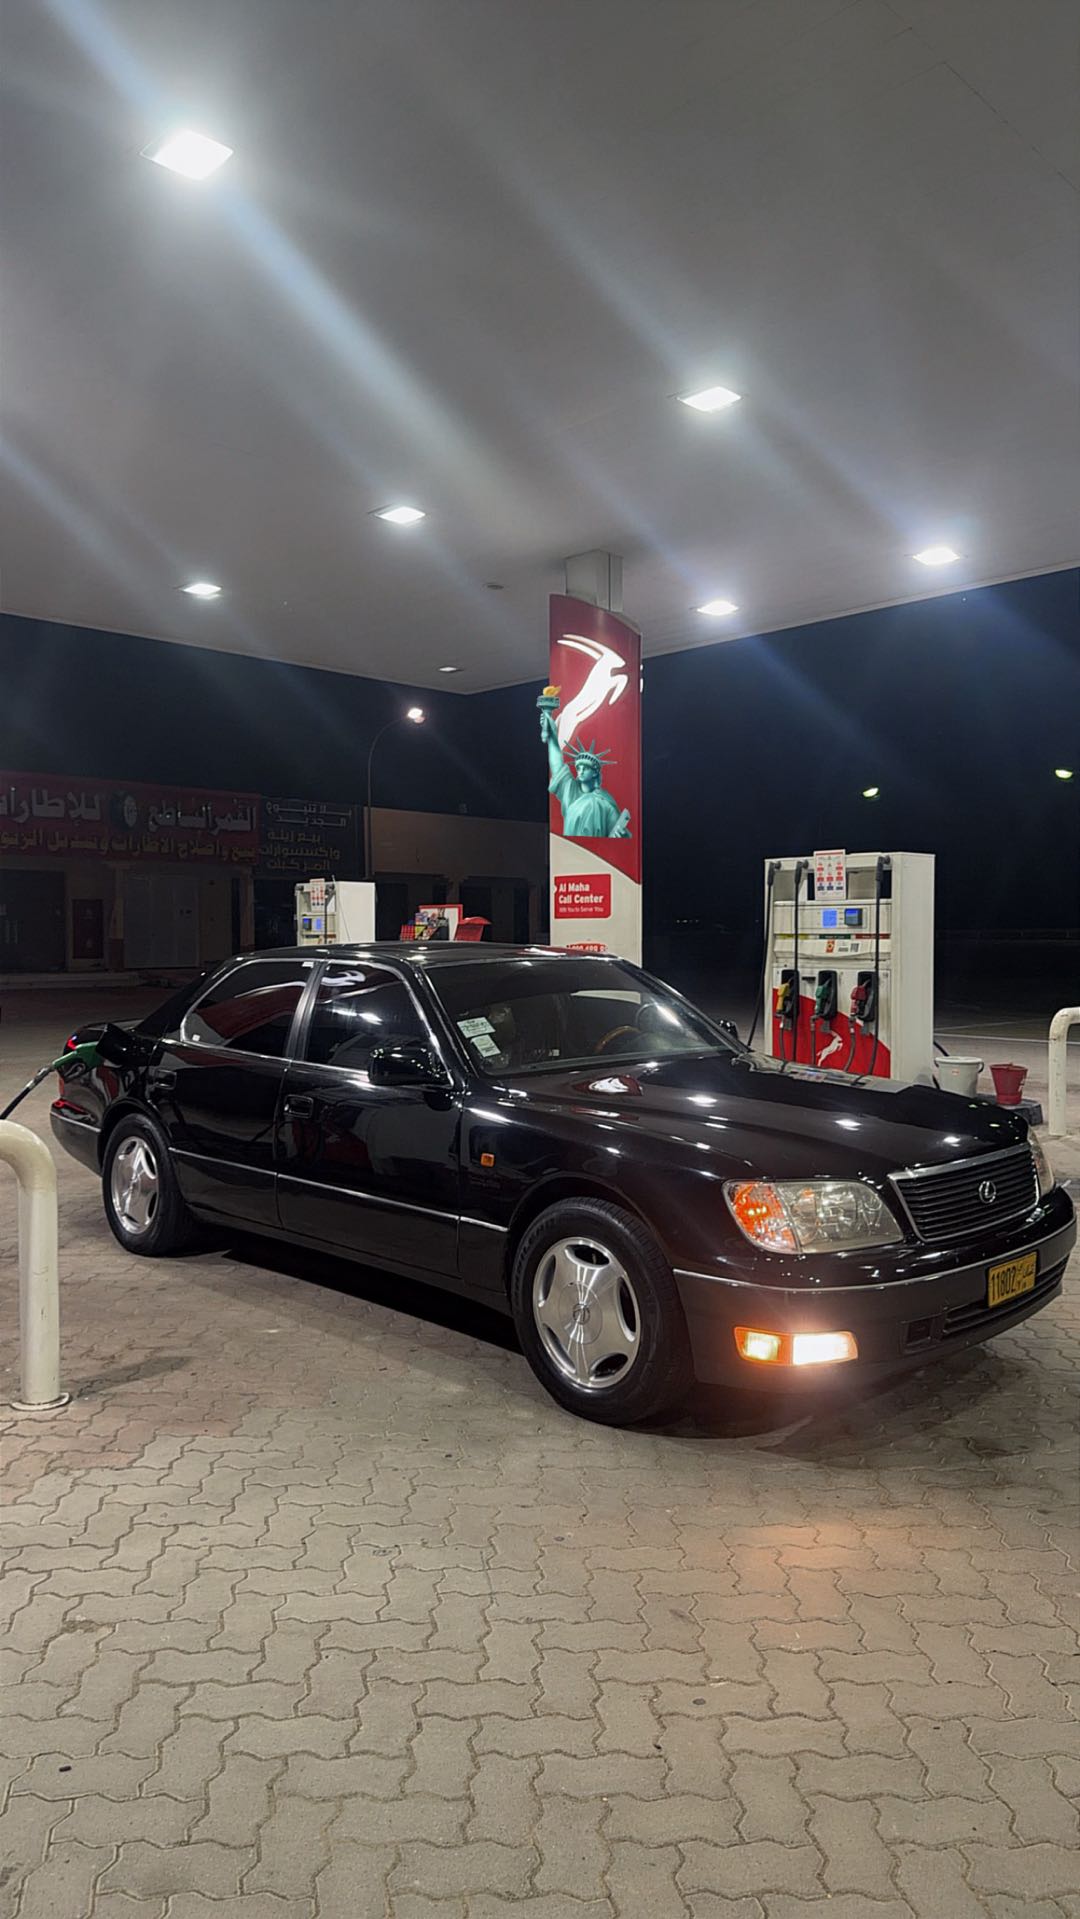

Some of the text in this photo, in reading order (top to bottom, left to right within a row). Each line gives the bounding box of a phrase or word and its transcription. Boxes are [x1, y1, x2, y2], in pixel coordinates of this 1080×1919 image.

[148, 797, 213, 833] الساطع
[207, 798, 257, 836] القمر
[559, 882, 591, 892] Al Maha
[559, 894, 604, 904] Call Center
[992, 1265, 1017, 1302] 11802
